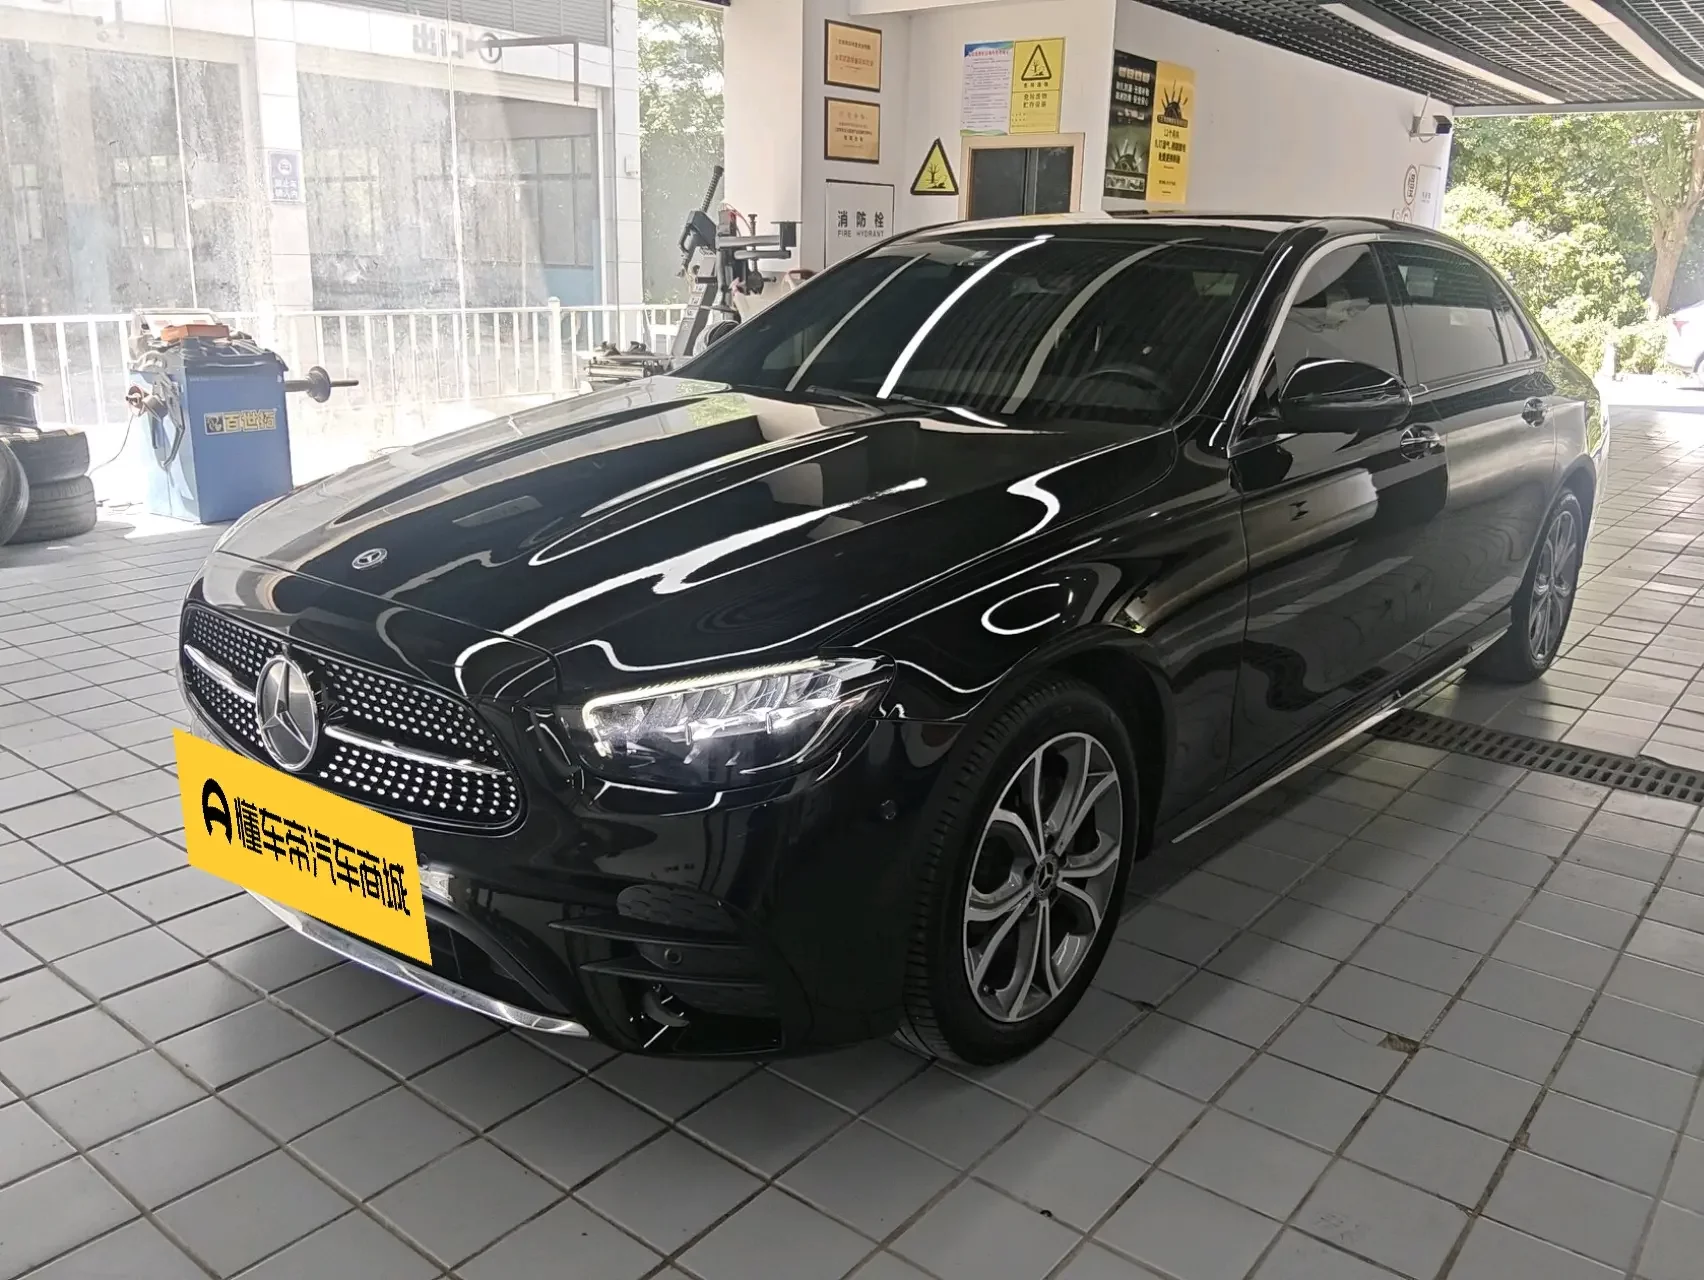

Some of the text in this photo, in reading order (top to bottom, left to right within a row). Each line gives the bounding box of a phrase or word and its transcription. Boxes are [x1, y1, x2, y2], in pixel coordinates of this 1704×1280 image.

[837, 210, 885, 228] 消防栓
[837, 229, 885, 237] FIRE HYDRANT
